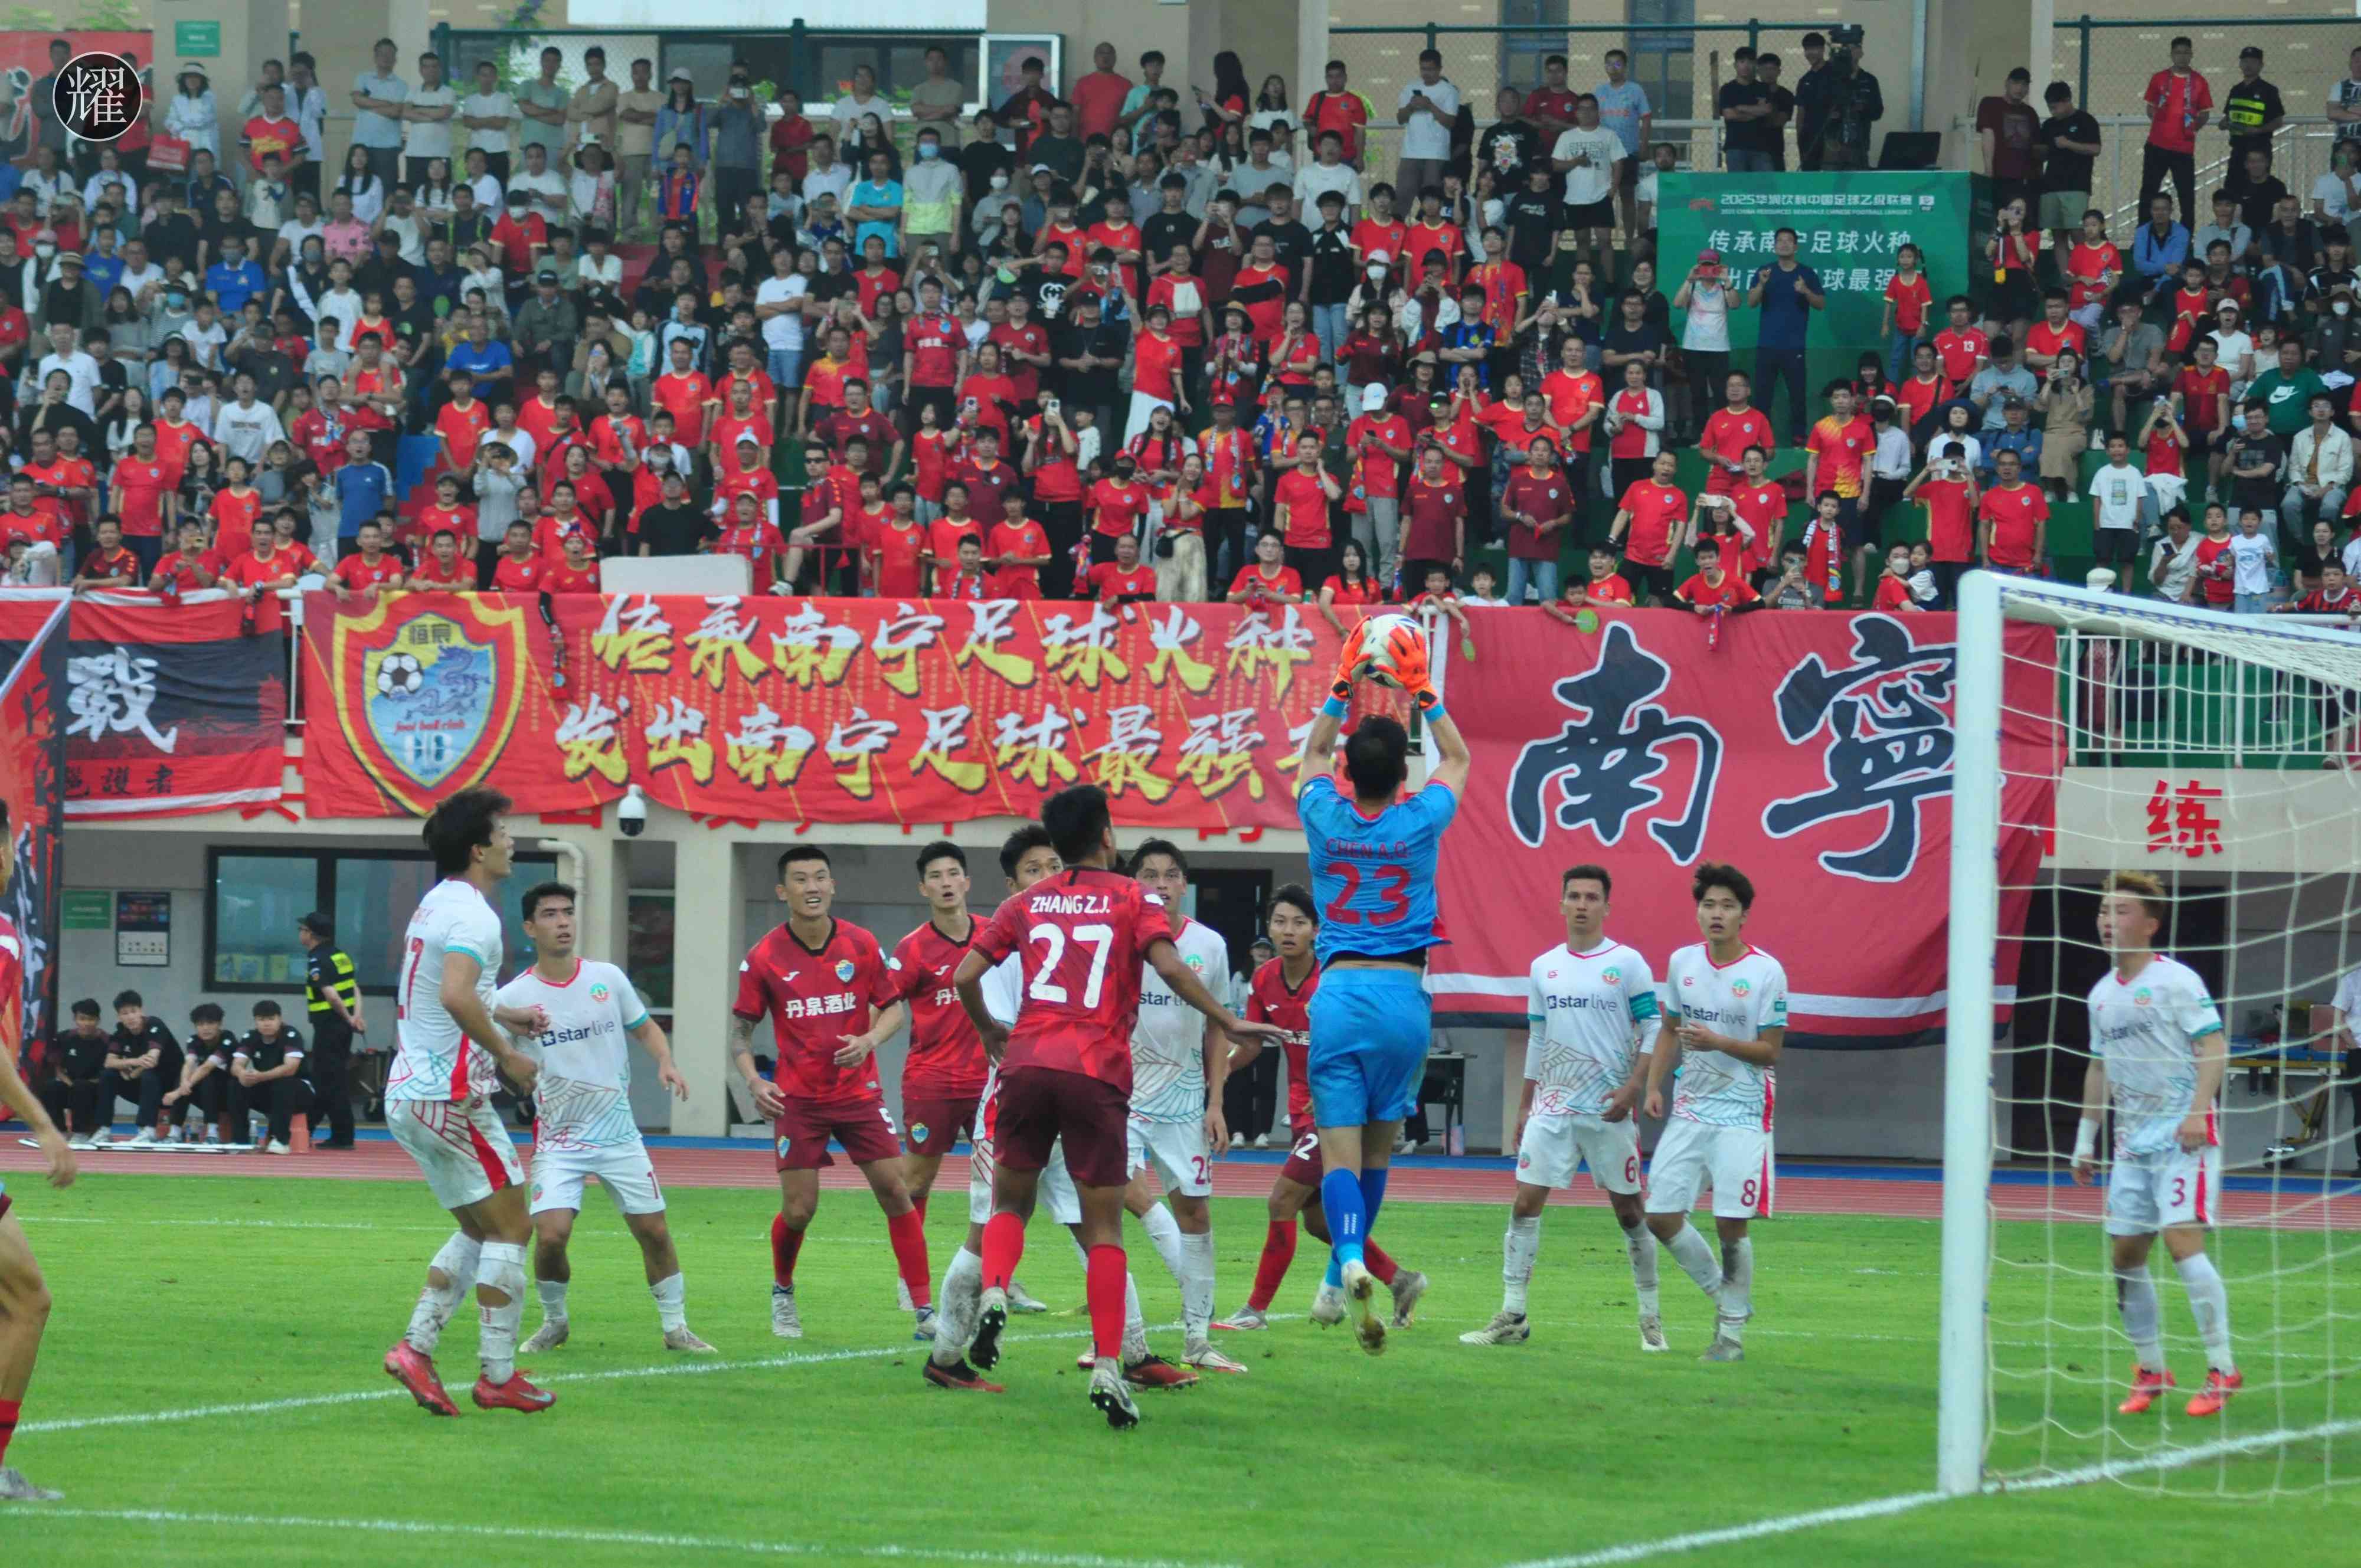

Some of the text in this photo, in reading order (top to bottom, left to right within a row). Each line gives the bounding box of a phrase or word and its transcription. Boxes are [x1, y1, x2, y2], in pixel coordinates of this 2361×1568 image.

[1963, 341, 1974, 352] 13
[591, 592, 1316, 702] 传承南宁足球火种
[1507, 612, 2005, 883] 南寧
[2147, 780, 2223, 857] 练
[1326, 838, 1372, 859] CHEN
[1029, 895, 1083, 914] ZHANG
[1326, 861, 1411, 927] 23
[397, 935, 424, 1020] 7
[1029, 923, 1114, 1009] 27
[785, 991, 856, 1019] 丹泉酒业
[1139, 991, 1172, 1006] star
[1559, 993, 1618, 1012] star live
[1693, 1007, 1747, 1026] star live
[557, 1020, 615, 1043] star live
[878, 1107, 897, 1135] 5
[1624, 1155, 1638, 1184] 6
[1740, 1179, 1757, 1207] 8
[2170, 1177, 2185, 1207] 3
